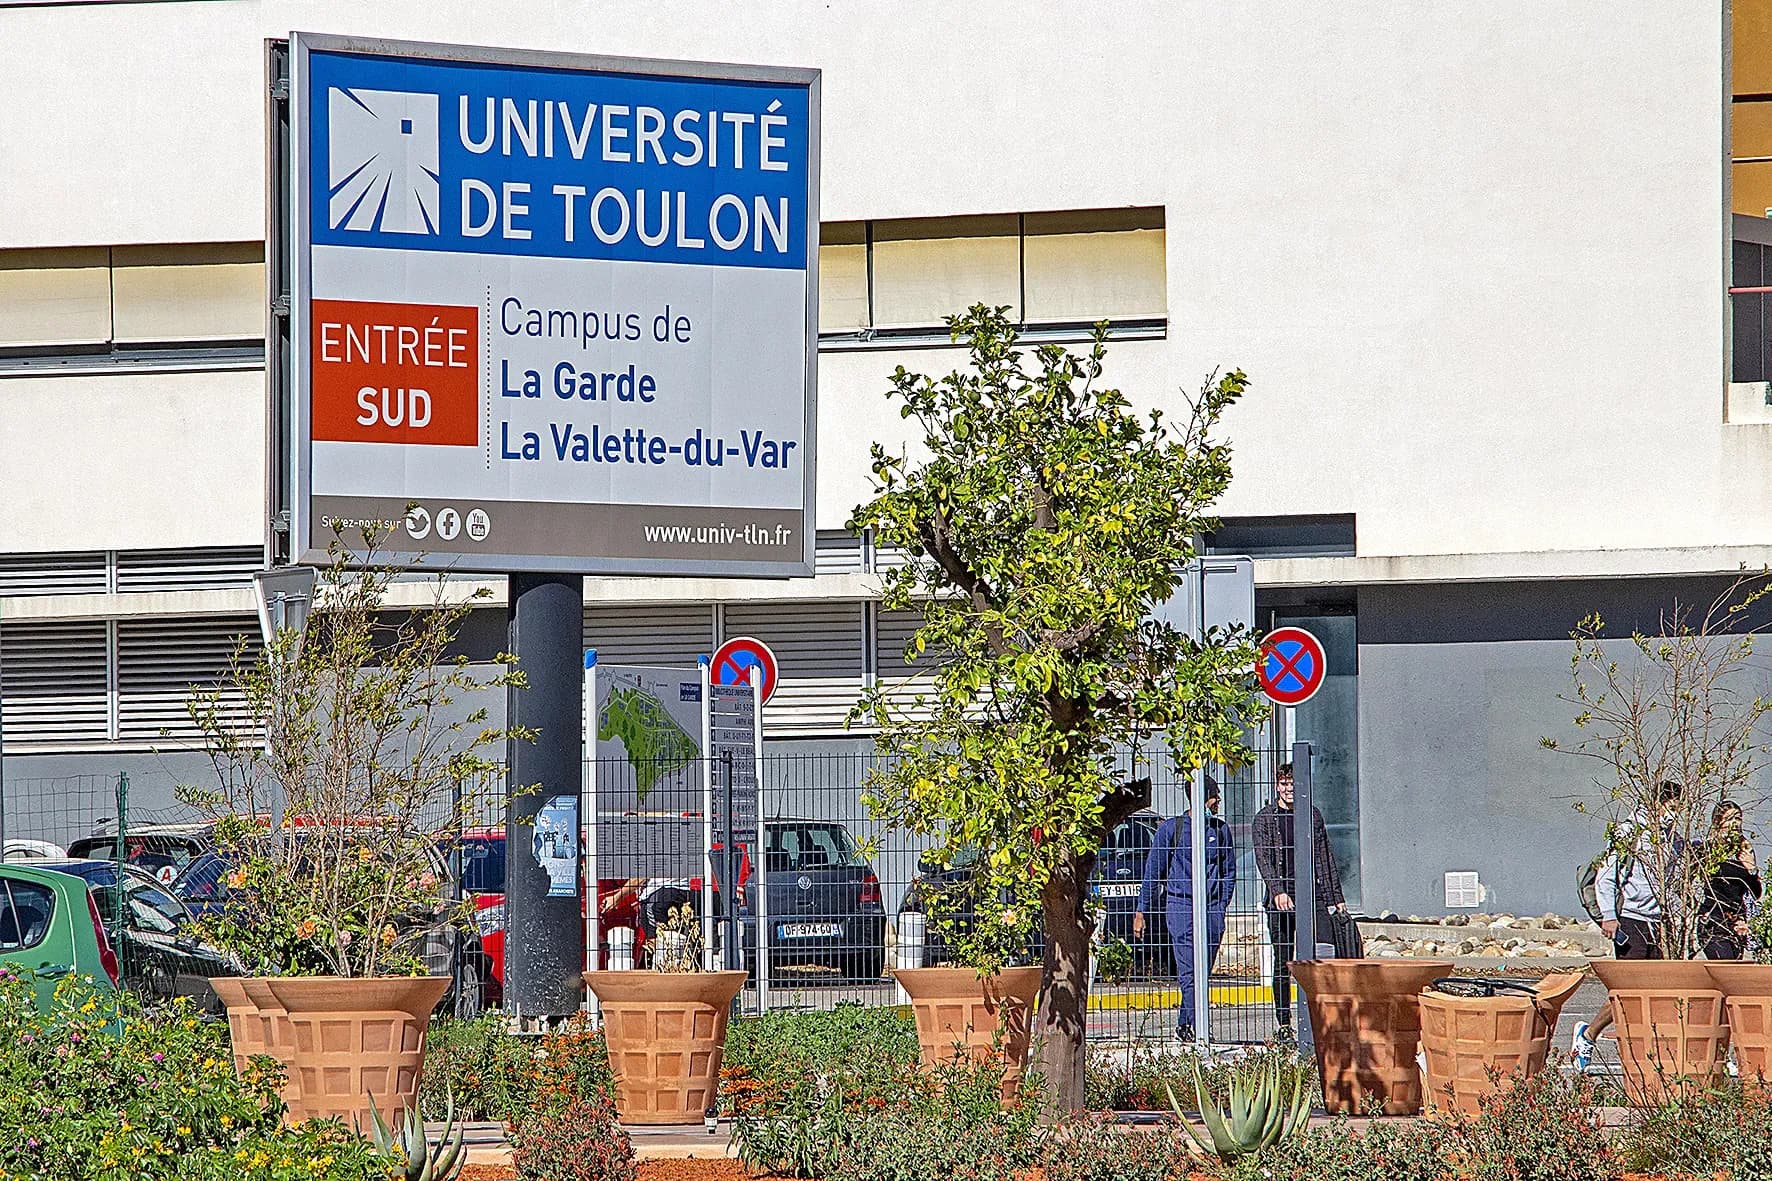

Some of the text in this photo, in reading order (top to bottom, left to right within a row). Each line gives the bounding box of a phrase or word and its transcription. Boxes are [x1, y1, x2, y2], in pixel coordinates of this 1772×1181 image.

[459, 94, 789, 172] UNIVERSITÉ
[461, 179, 789, 254] DE TOULON
[321, 317, 468, 368] ENTRÉE
[501, 297, 692, 350] Campus de
[501, 360, 657, 403] La Garde
[356, 386, 432, 428] SUD
[501, 422, 797, 469] La Valette-du-Var
[644, 522, 792, 546] www.univ-tln.fr
